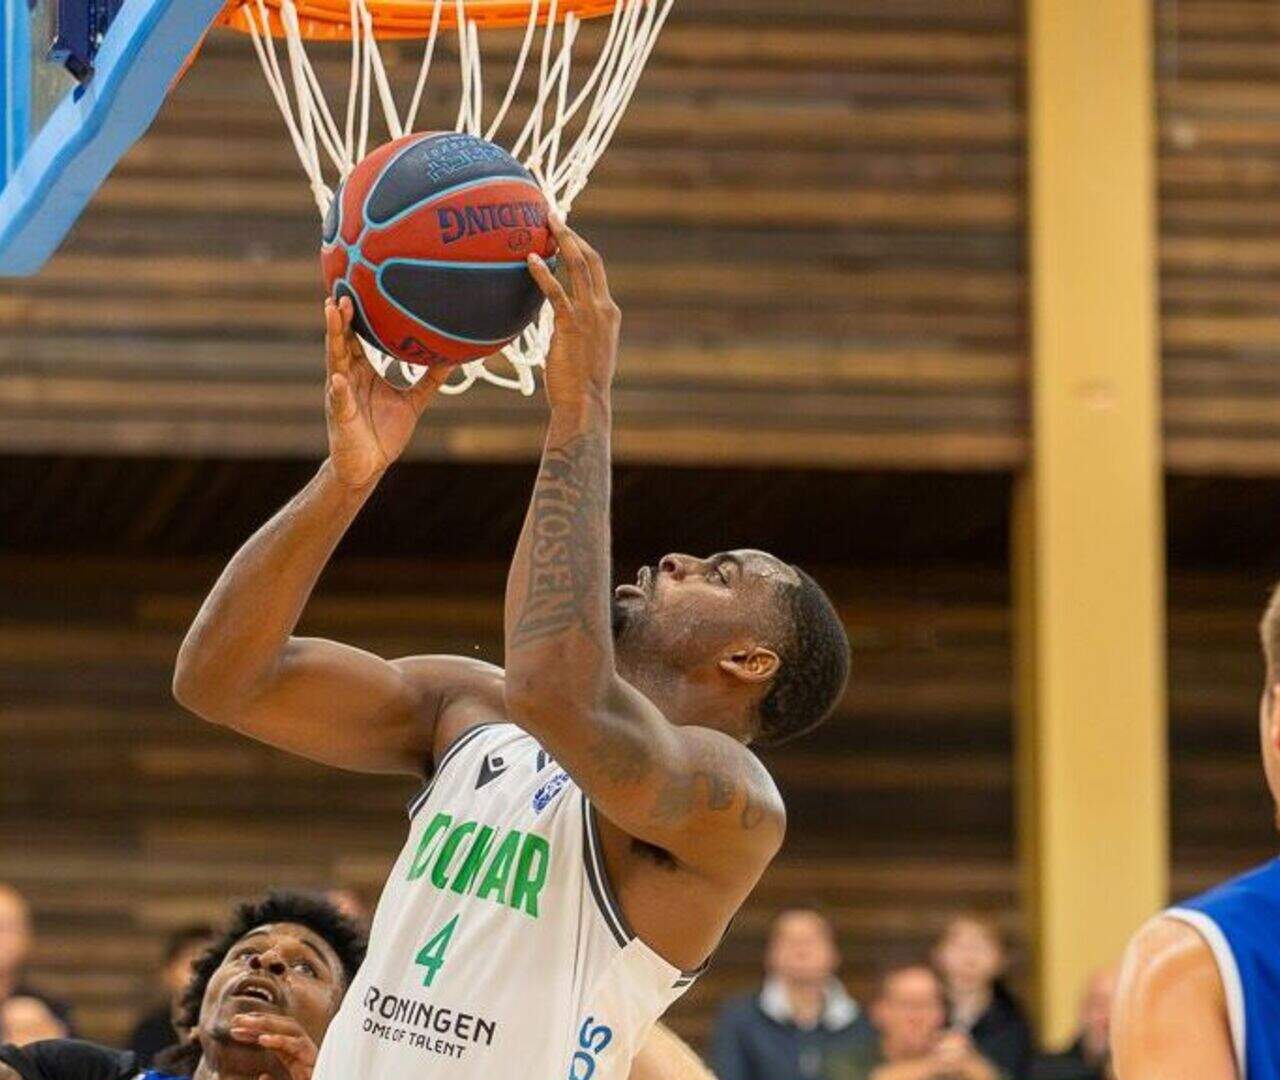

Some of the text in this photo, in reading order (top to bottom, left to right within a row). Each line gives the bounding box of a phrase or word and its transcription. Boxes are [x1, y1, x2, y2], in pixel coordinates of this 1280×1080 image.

[415, 913, 460, 987] 4
[362, 1017, 392, 1041] OME
[408, 1031, 467, 1059] TALENT
[364, 985, 497, 1046] RONINGEN
